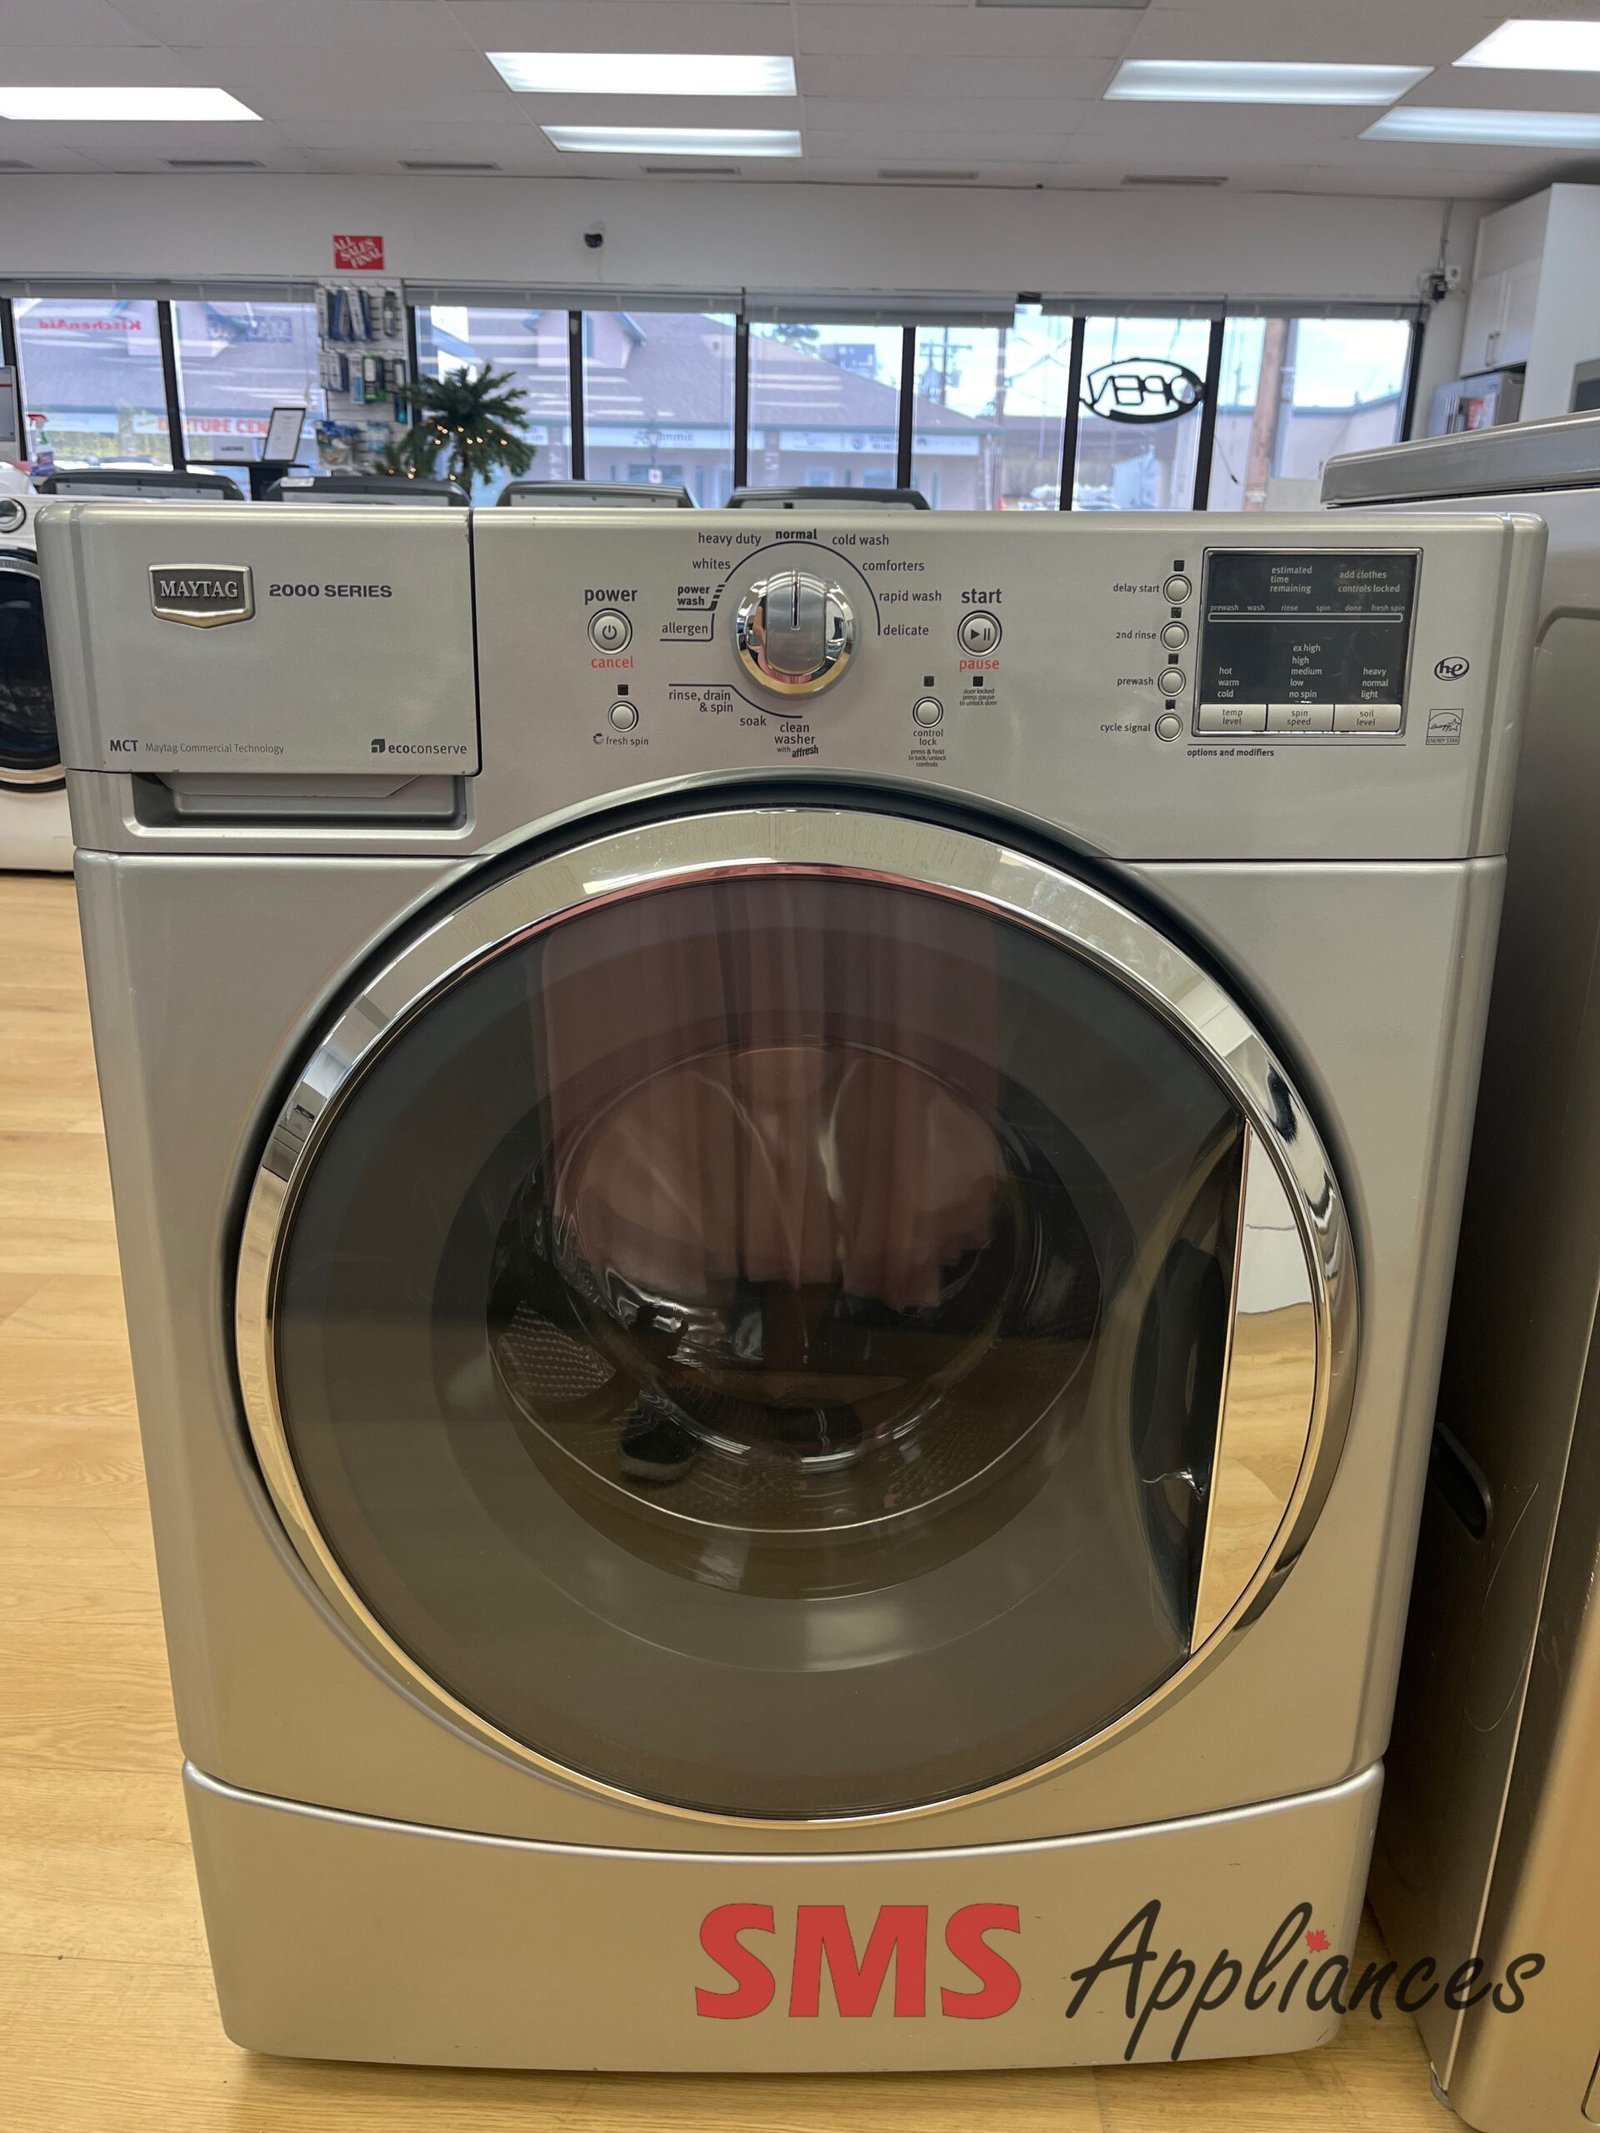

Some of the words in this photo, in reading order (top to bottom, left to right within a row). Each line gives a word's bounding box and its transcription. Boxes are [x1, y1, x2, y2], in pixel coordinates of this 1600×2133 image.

[333, 236, 352, 250] ALL
[341, 239, 375, 261] SALES
[350, 248, 381, 268] FINAL
[698, 532, 732, 546] heavy
[736, 533, 761, 546] duty
[775, 529, 817, 540] normal
[832, 534, 856, 545] cold
[859, 534, 889, 545] wash
[692, 558, 731, 570] whites
[862, 560, 925, 571] comforters
[1271, 565, 1313, 575] estimated
[1339, 570, 1355, 579] add
[1357, 570, 1387, 579] clothes
[1271, 575, 1289, 583] time
[160, 580, 238, 598] MAYTAG
[269, 584, 319, 597] 2000
[325, 584, 392, 598] SERIES
[677, 585, 710, 596] power
[1113, 583, 1136, 594] delay
[1139, 583, 1160, 593] start
[1270, 584, 1312, 595] remaining
[1338, 584, 1371, 593] controls
[1373, 584, 1400, 593] locked
[584, 588, 637, 605] power
[677, 596, 705, 606] wash
[879, 590, 909, 604] rapid
[912, 590, 942, 602] wash
[961, 588, 1002, 604] start
[1210, 604, 1239, 612] prewash
[1247, 604, 1265, 612] wash
[1316, 604, 1331, 612] spin
[1390, 604, 1405, 612] spin
[662, 622, 708, 636] allergen
[883, 624, 929, 636] delicate
[1116, 631, 1132, 640] 2nd
[1135, 631, 1157, 640] rinse
[1303, 643, 1321, 654] high
[591, 656, 634, 668] cancel
[959, 660, 1000, 672] pause
[1292, 655, 1309, 666] high
[1219, 667, 1232, 675] hot
[1291, 667, 1322, 675] medium
[1363, 667, 1387, 678] heavy
[1117, 677, 1154, 687] prewash
[1218, 679, 1240, 687] warm
[1290, 678, 1304, 687] low
[1362, 679, 1389, 687] normal
[669, 689, 700, 702] rinse,
[703, 689, 731, 701] drain
[1217, 689, 1234, 698] cold
[1300, 689, 1317, 699] spin
[1361, 689, 1378, 699] light
[699, 702, 708, 712] &
[710, 702, 733, 714] spin
[1222, 709, 1243, 718] temp
[1291, 709, 1309, 718] spin
[1360, 709, 1374, 717] soil
[740, 715, 766, 727] soak
[1222, 717, 1242, 725] level
[1287, 717, 1312, 726] speed
[1356, 717, 1376, 726] level
[780, 721, 809, 733] clean
[1100, 723, 1122, 733] cycle
[1124, 723, 1150, 733] signal
[774, 734, 816, 744] washer
[913, 729, 944, 738] control
[110, 739, 138, 752] MCT
[145, 742, 178, 754] Maytag
[180, 743, 232, 753] Commercial
[234, 743, 284, 755] Technology
[606, 737, 628, 746] fresh
[630, 737, 649, 748] spin
[919, 738, 937, 746] lock
[388, 743, 467, 755] ecoconserve
[792, 744, 819, 758] affresh
[1187, 748, 1217, 758] options
[1219, 748, 1235, 757] and
[1236, 748, 1275, 757] modifiers
